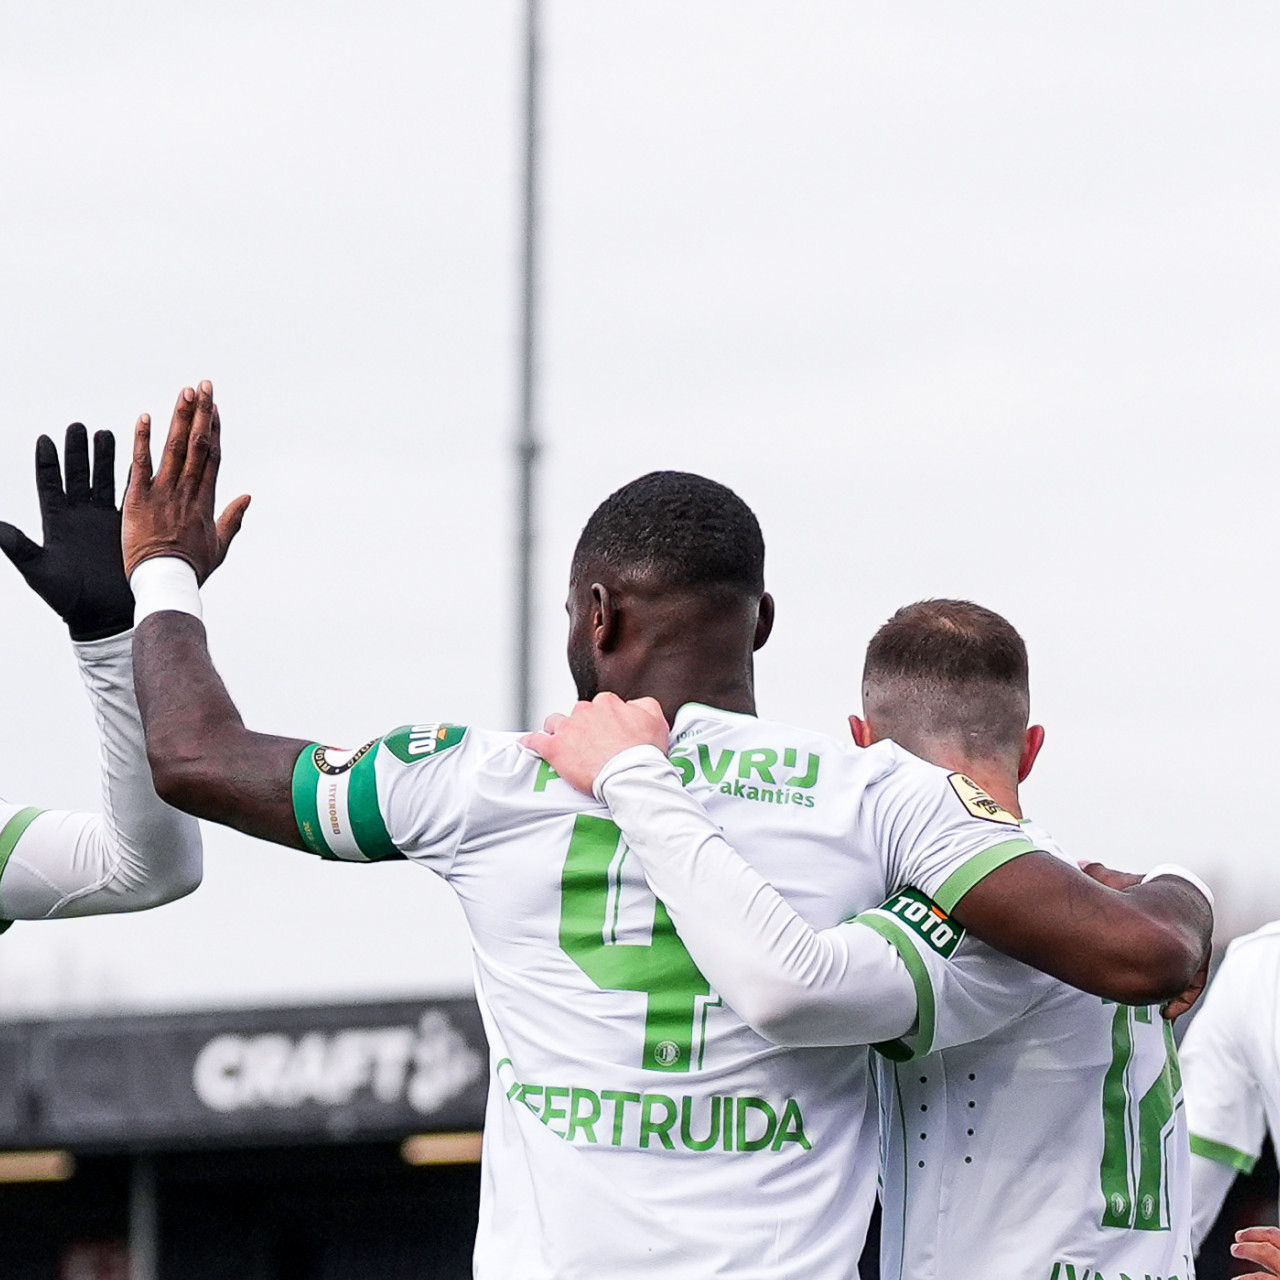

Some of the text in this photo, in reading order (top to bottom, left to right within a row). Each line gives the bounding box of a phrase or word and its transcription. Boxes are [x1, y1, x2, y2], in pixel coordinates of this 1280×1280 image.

[719, 778, 816, 808] akanties
[558, 813, 722, 1072] 4
[891, 896, 954, 948] TOTO
[192, 1024, 414, 1113] CRAFT
